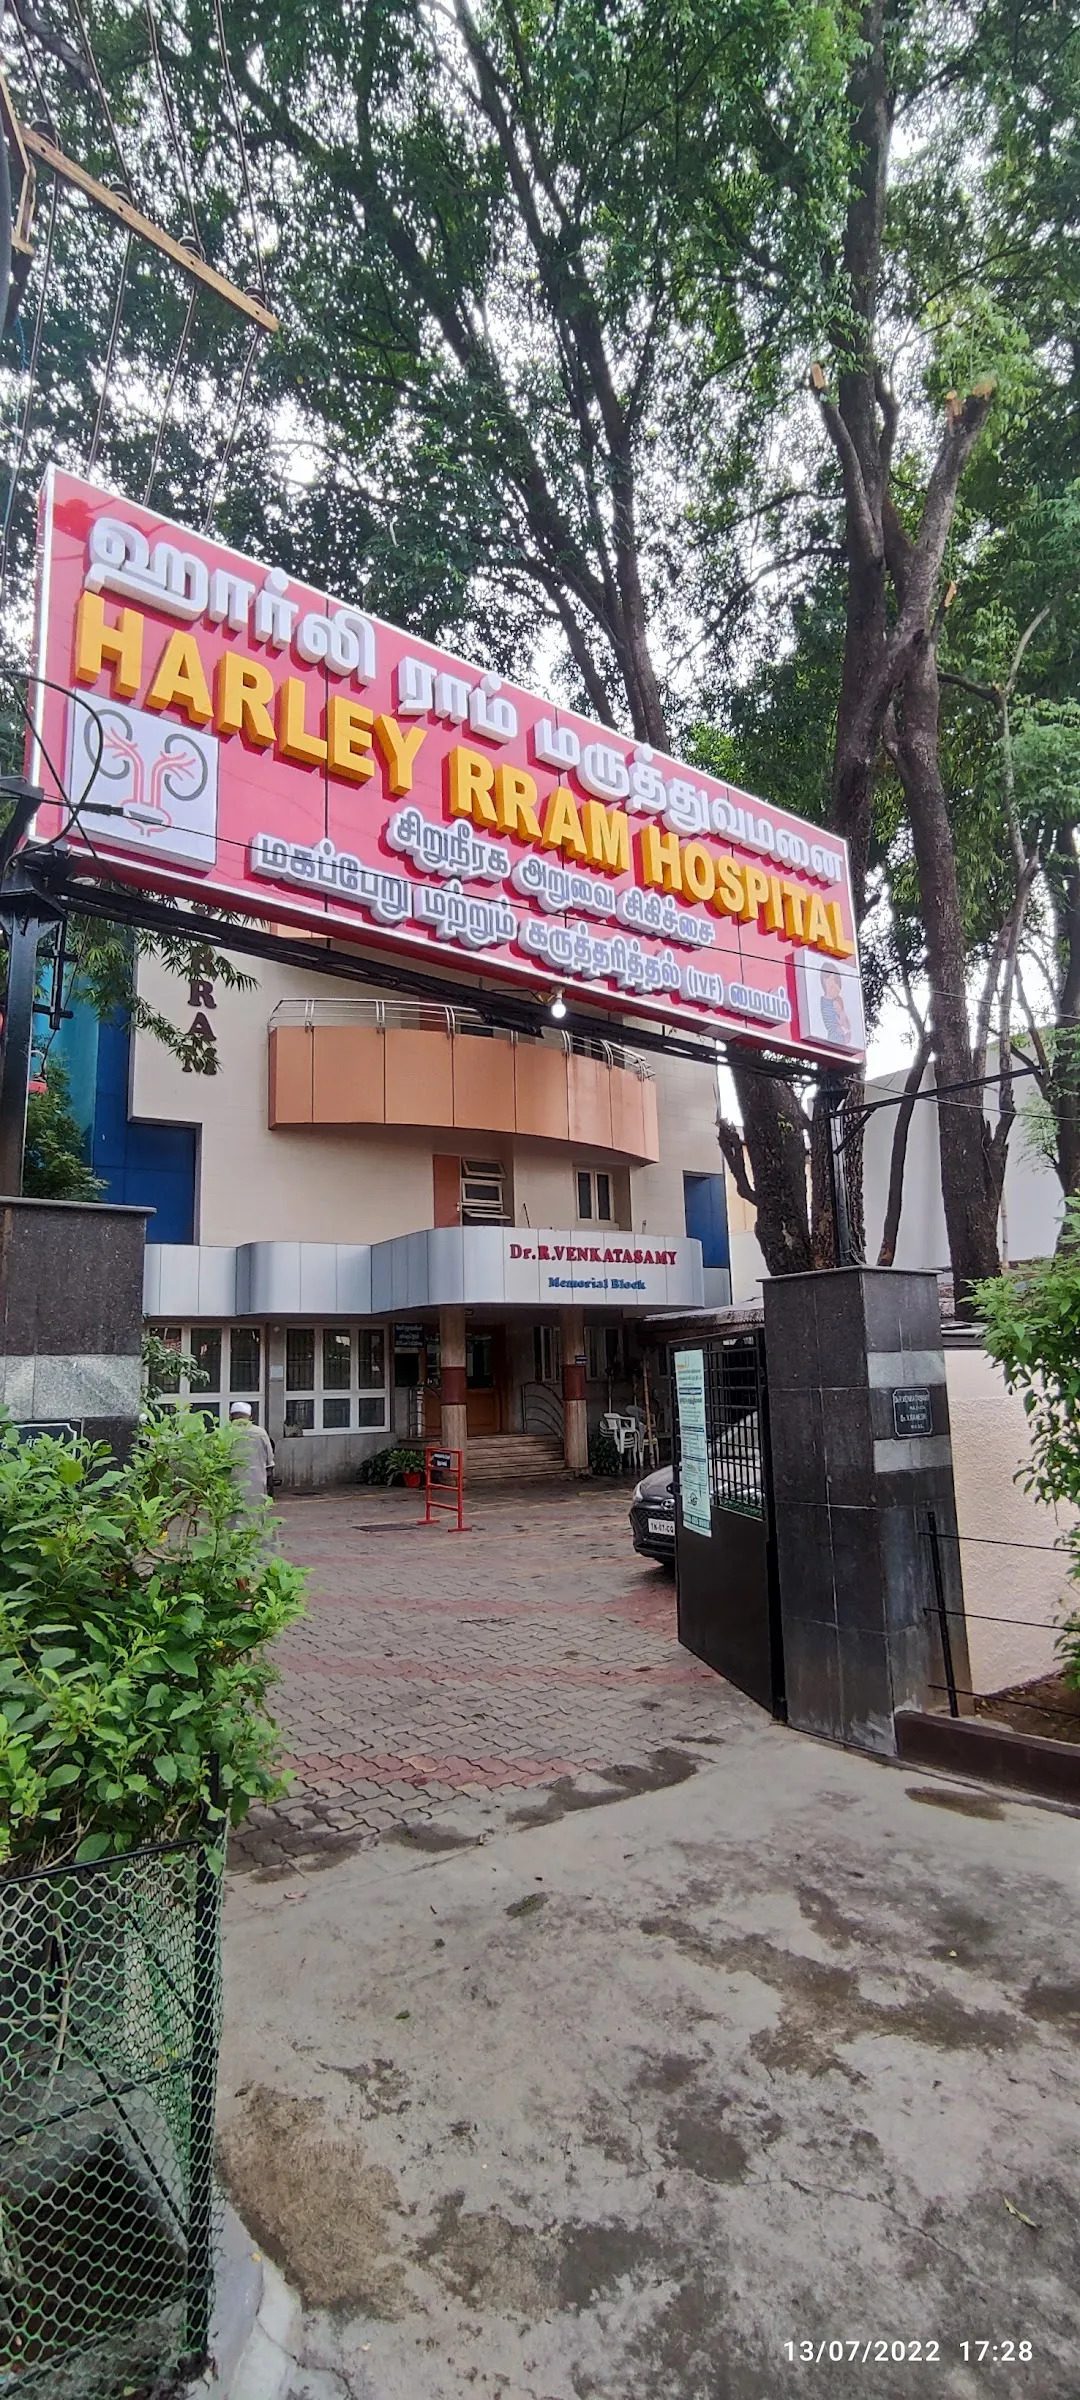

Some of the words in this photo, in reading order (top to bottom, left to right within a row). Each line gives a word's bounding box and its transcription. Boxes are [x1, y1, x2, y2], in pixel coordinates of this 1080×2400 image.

[75, 590, 426, 796] HARLEY
[449, 745, 630, 875] RRAM
[638, 824, 856, 959] HOSPITAL
[85, 517, 376, 685] ஹார்லி
[397, 655, 518, 744] ராம்
[535, 718, 844, 885] மருத்துவமனை
[258, 836, 411, 918] மகப்பேறு
[421, 881, 515, 941] மற்றும்
[525, 921, 681, 989] கருத்தரித்தல்
[687, 966, 723, 1005] (IVF)
[729, 983, 791, 1022] மையம்
[393, 808, 509, 877] சிறுநீரக
[518, 856, 615, 913] அறுவை
[622, 889, 714, 945] சிகிச்சை
[548, 1277, 608, 1290] Memorial
[611, 1278, 646, 1291] Block
